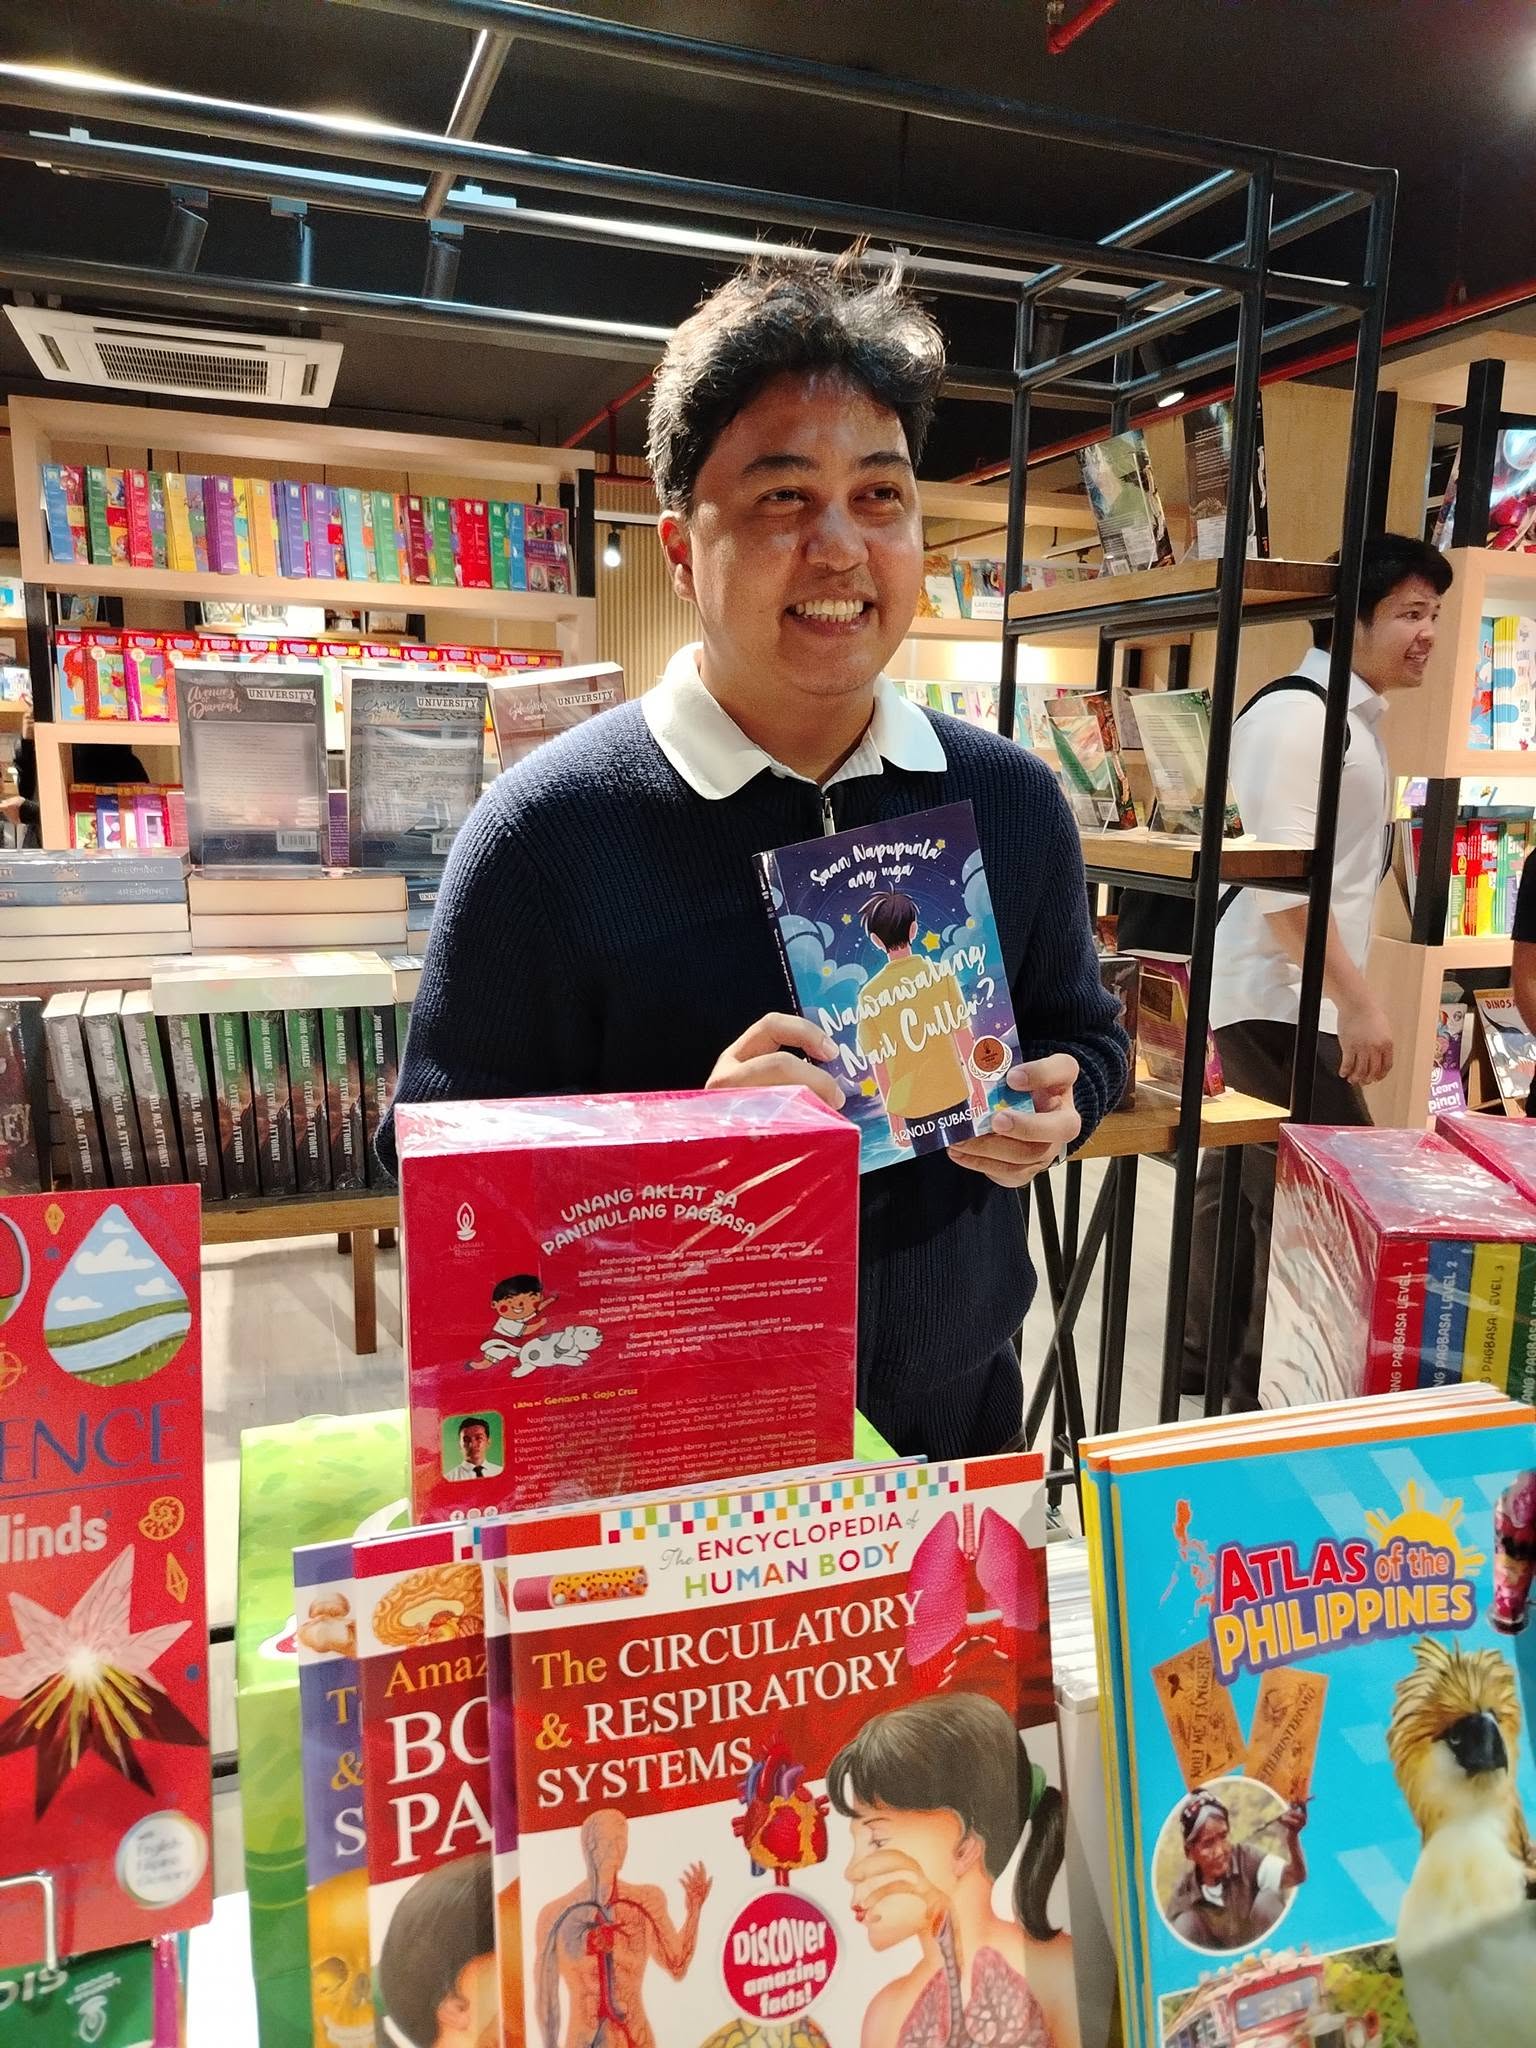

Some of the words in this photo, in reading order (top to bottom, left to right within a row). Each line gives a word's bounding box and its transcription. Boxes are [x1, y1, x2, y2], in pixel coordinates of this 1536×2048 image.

[249, 688, 314, 701] UNIVERSITY
[417, 697, 478, 709] UNIVERSITY
[558, 690, 614, 706] UNIVERSITY
[810, 857, 852, 887] Saan
[847, 869, 877, 889] ang
[881, 864, 914, 880] mga
[817, 943, 987, 1037] Nawawalang
[837, 1035, 898, 1078] Nail
[1431, 1082, 1459, 1096] Learn
[893, 1121, 936, 1143] ARNOLD
[561, 1188, 633, 1222] UNANG
[642, 1185, 707, 1201] AKLAT
[713, 1189, 738, 1209] SA
[541, 1205, 667, 1256] PANIMULANG
[674, 1205, 757, 1238] PAGBASA
[1392, 1315, 1410, 1369] PAGBASA
[1436, 1312, 1454, 1369] PAGBASA
[1480, 1316, 1498, 1371] PAGBASA
[544, 1394, 580, 1406] Genaro
[581, 1392, 592, 1401] R.
[593, 1390, 616, 1401] Gojo
[618, 1388, 638, 1396] Cruz
[0, 1505, 108, 1563] inds
[658, 1547, 695, 1571] The
[698, 1511, 903, 1562] ENCYCLOPEDIA
[906, 1509, 919, 1529] of
[685, 1557, 808, 1599] HUMAN
[819, 1541, 900, 1577] BODY
[1220, 1543, 1367, 1613] ATLAS
[1375, 1543, 1404, 1582] of
[1407, 1547, 1449, 1578] the
[532, 1650, 607, 1690] The
[618, 1589, 925, 1680] CIRCULATORY
[1213, 1585, 1473, 1675] PHILIPPINES
[534, 1713, 573, 1751] &
[584, 1648, 905, 1744] RESPIRATORY
[538, 1738, 754, 1809] SYSTEMS
[743, 1959, 827, 1997] amazing
[759, 1982, 812, 2016] facts!
